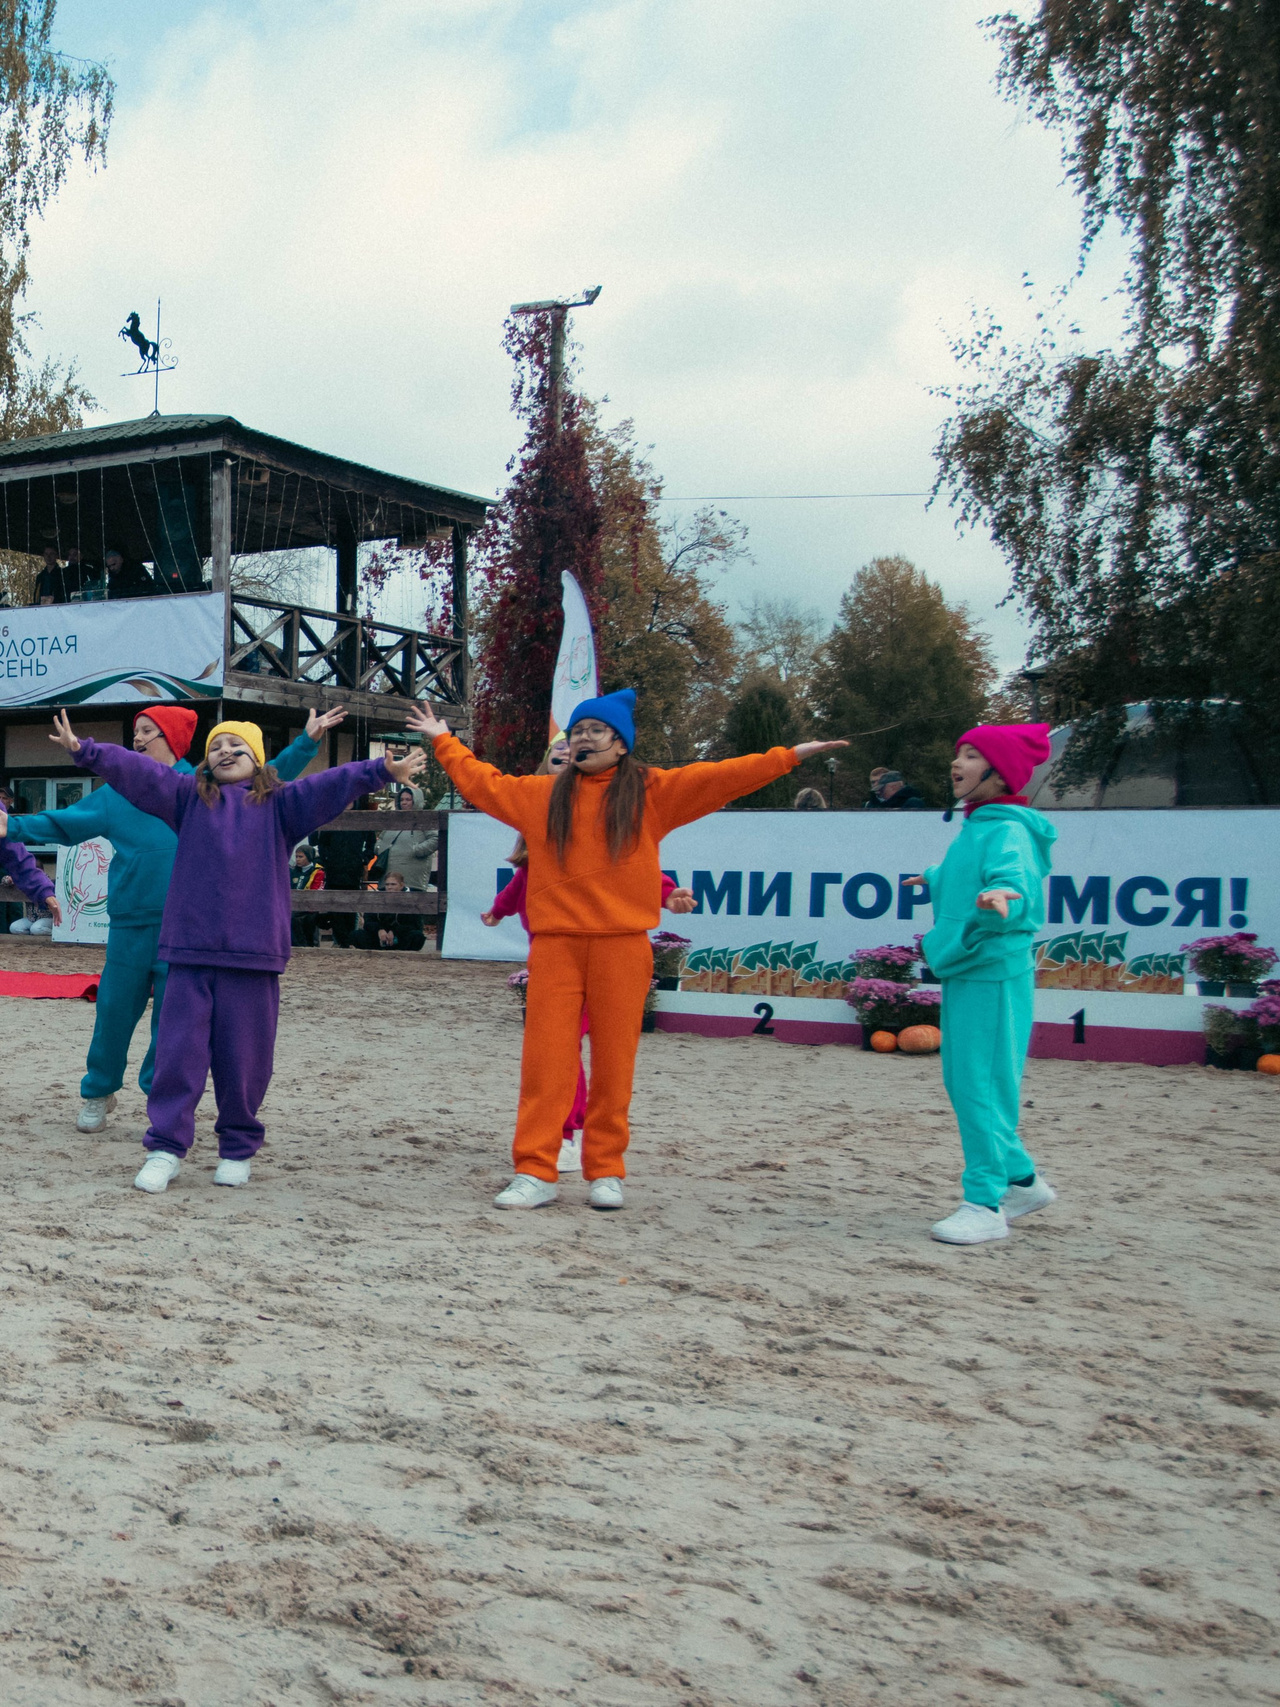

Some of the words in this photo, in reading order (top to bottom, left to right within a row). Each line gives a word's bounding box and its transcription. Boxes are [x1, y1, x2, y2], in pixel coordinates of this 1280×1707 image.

[661, 870, 792, 916] МИ
[809, 872, 1249, 930] ГОРМСЯ!
[753, 1002, 775, 1035] 2
[1068, 1008, 1085, 1044] 1
